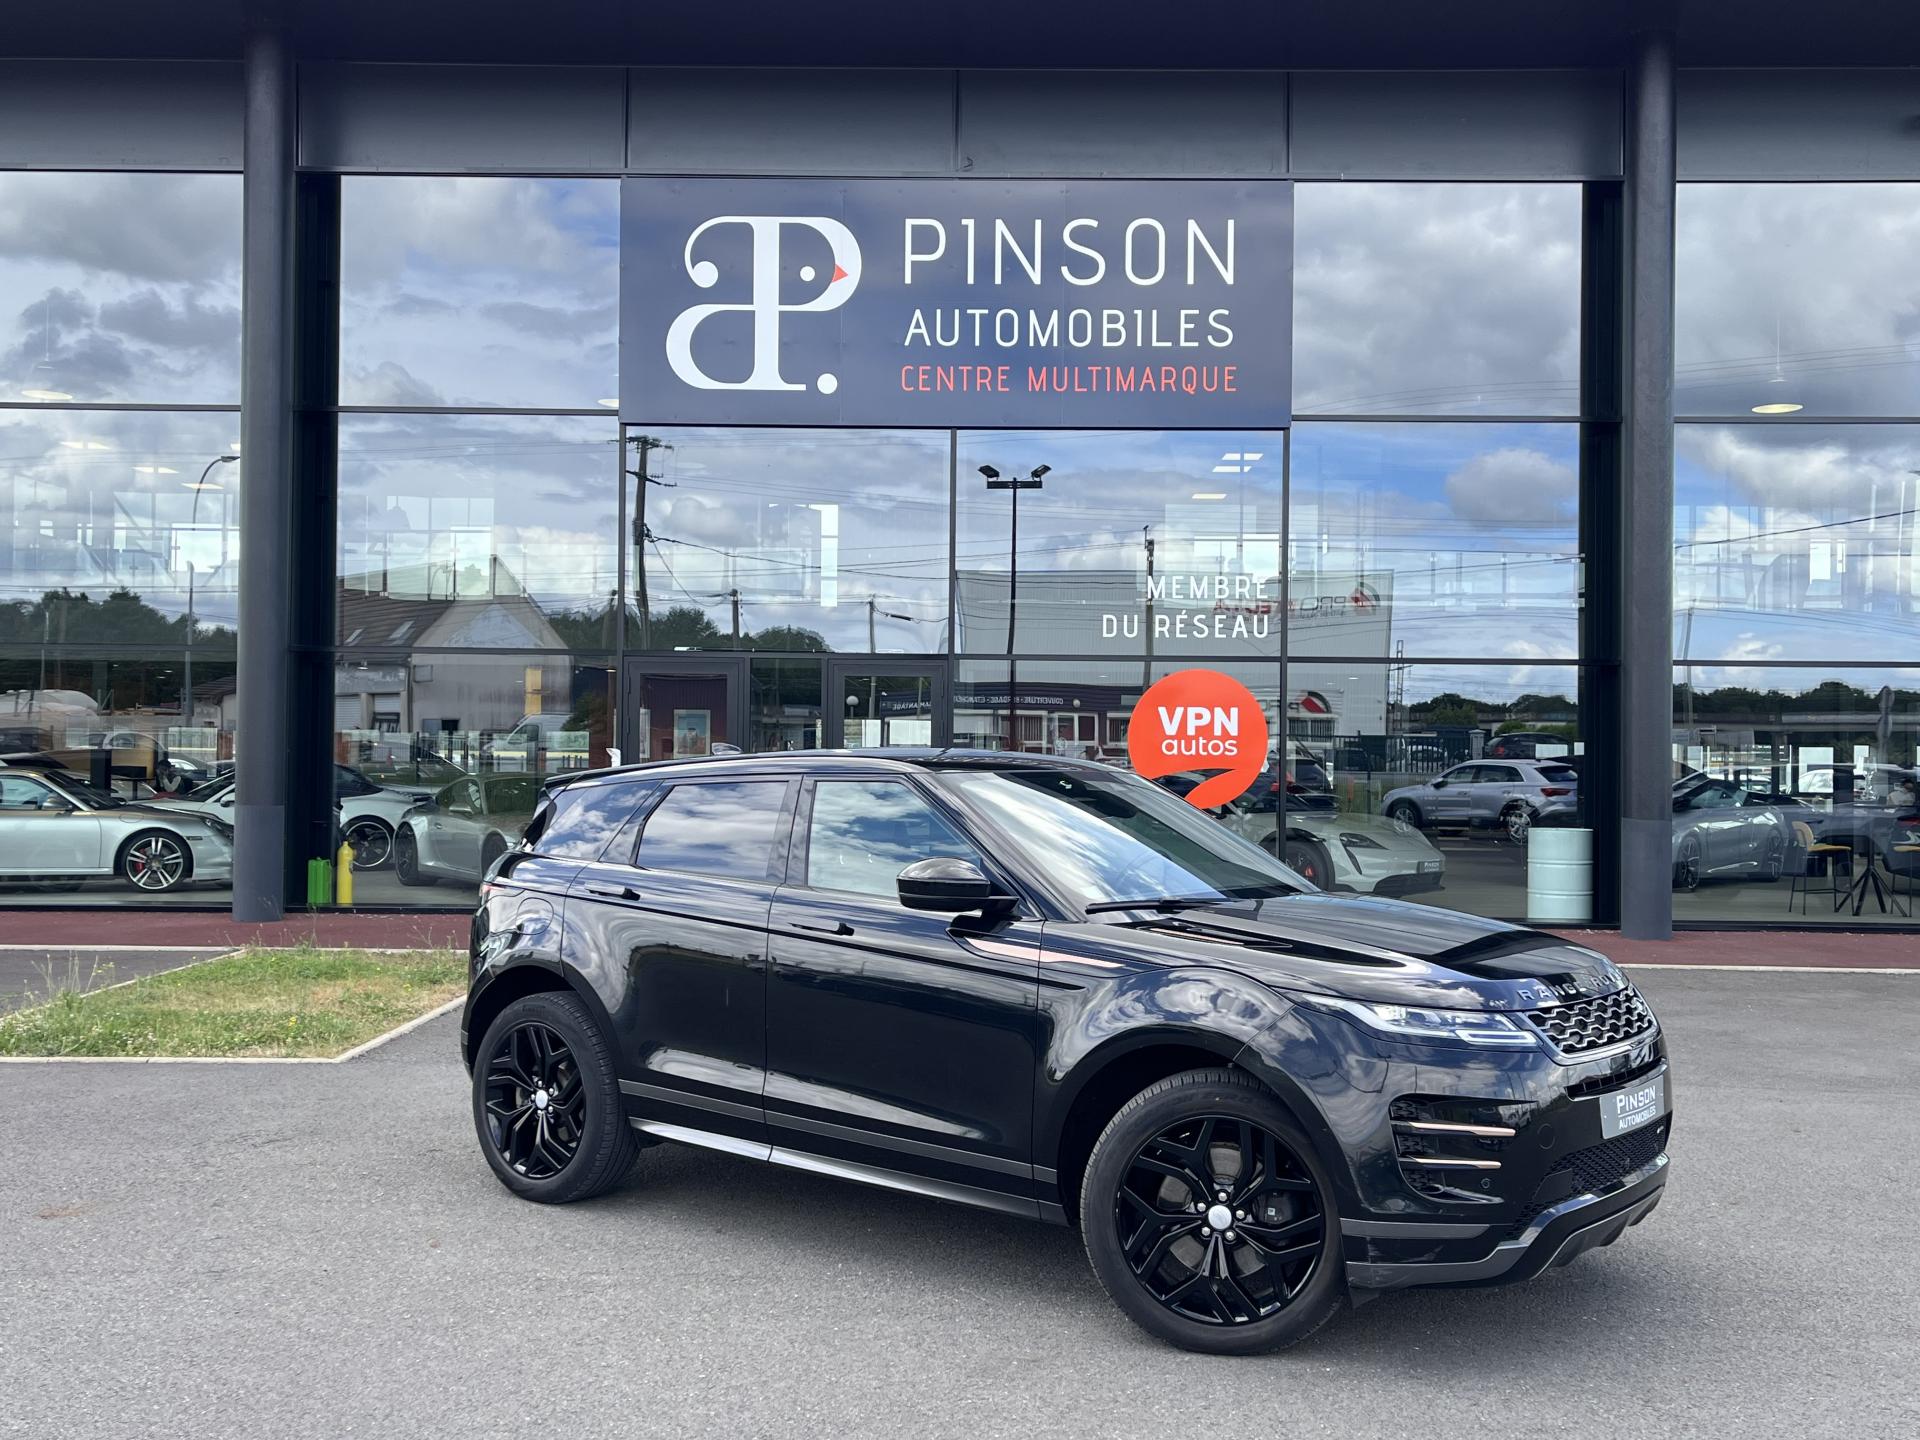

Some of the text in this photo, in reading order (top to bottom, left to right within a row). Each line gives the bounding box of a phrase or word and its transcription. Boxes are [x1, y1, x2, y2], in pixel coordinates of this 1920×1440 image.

[903, 217, 1235, 286] PINSON
[903, 309, 1234, 348] AUTOMOBILES
[901, 366, 1238, 394] CENTRE MULTIMARQUE
[1147, 575, 1268, 599] MEMBRE
[1102, 610, 1268, 638] DU RÉSEAU
[1157, 706, 1239, 737] VPN
[1161, 736, 1238, 756] autos
[1618, 1105, 1657, 1130] AUTOMOBILES
